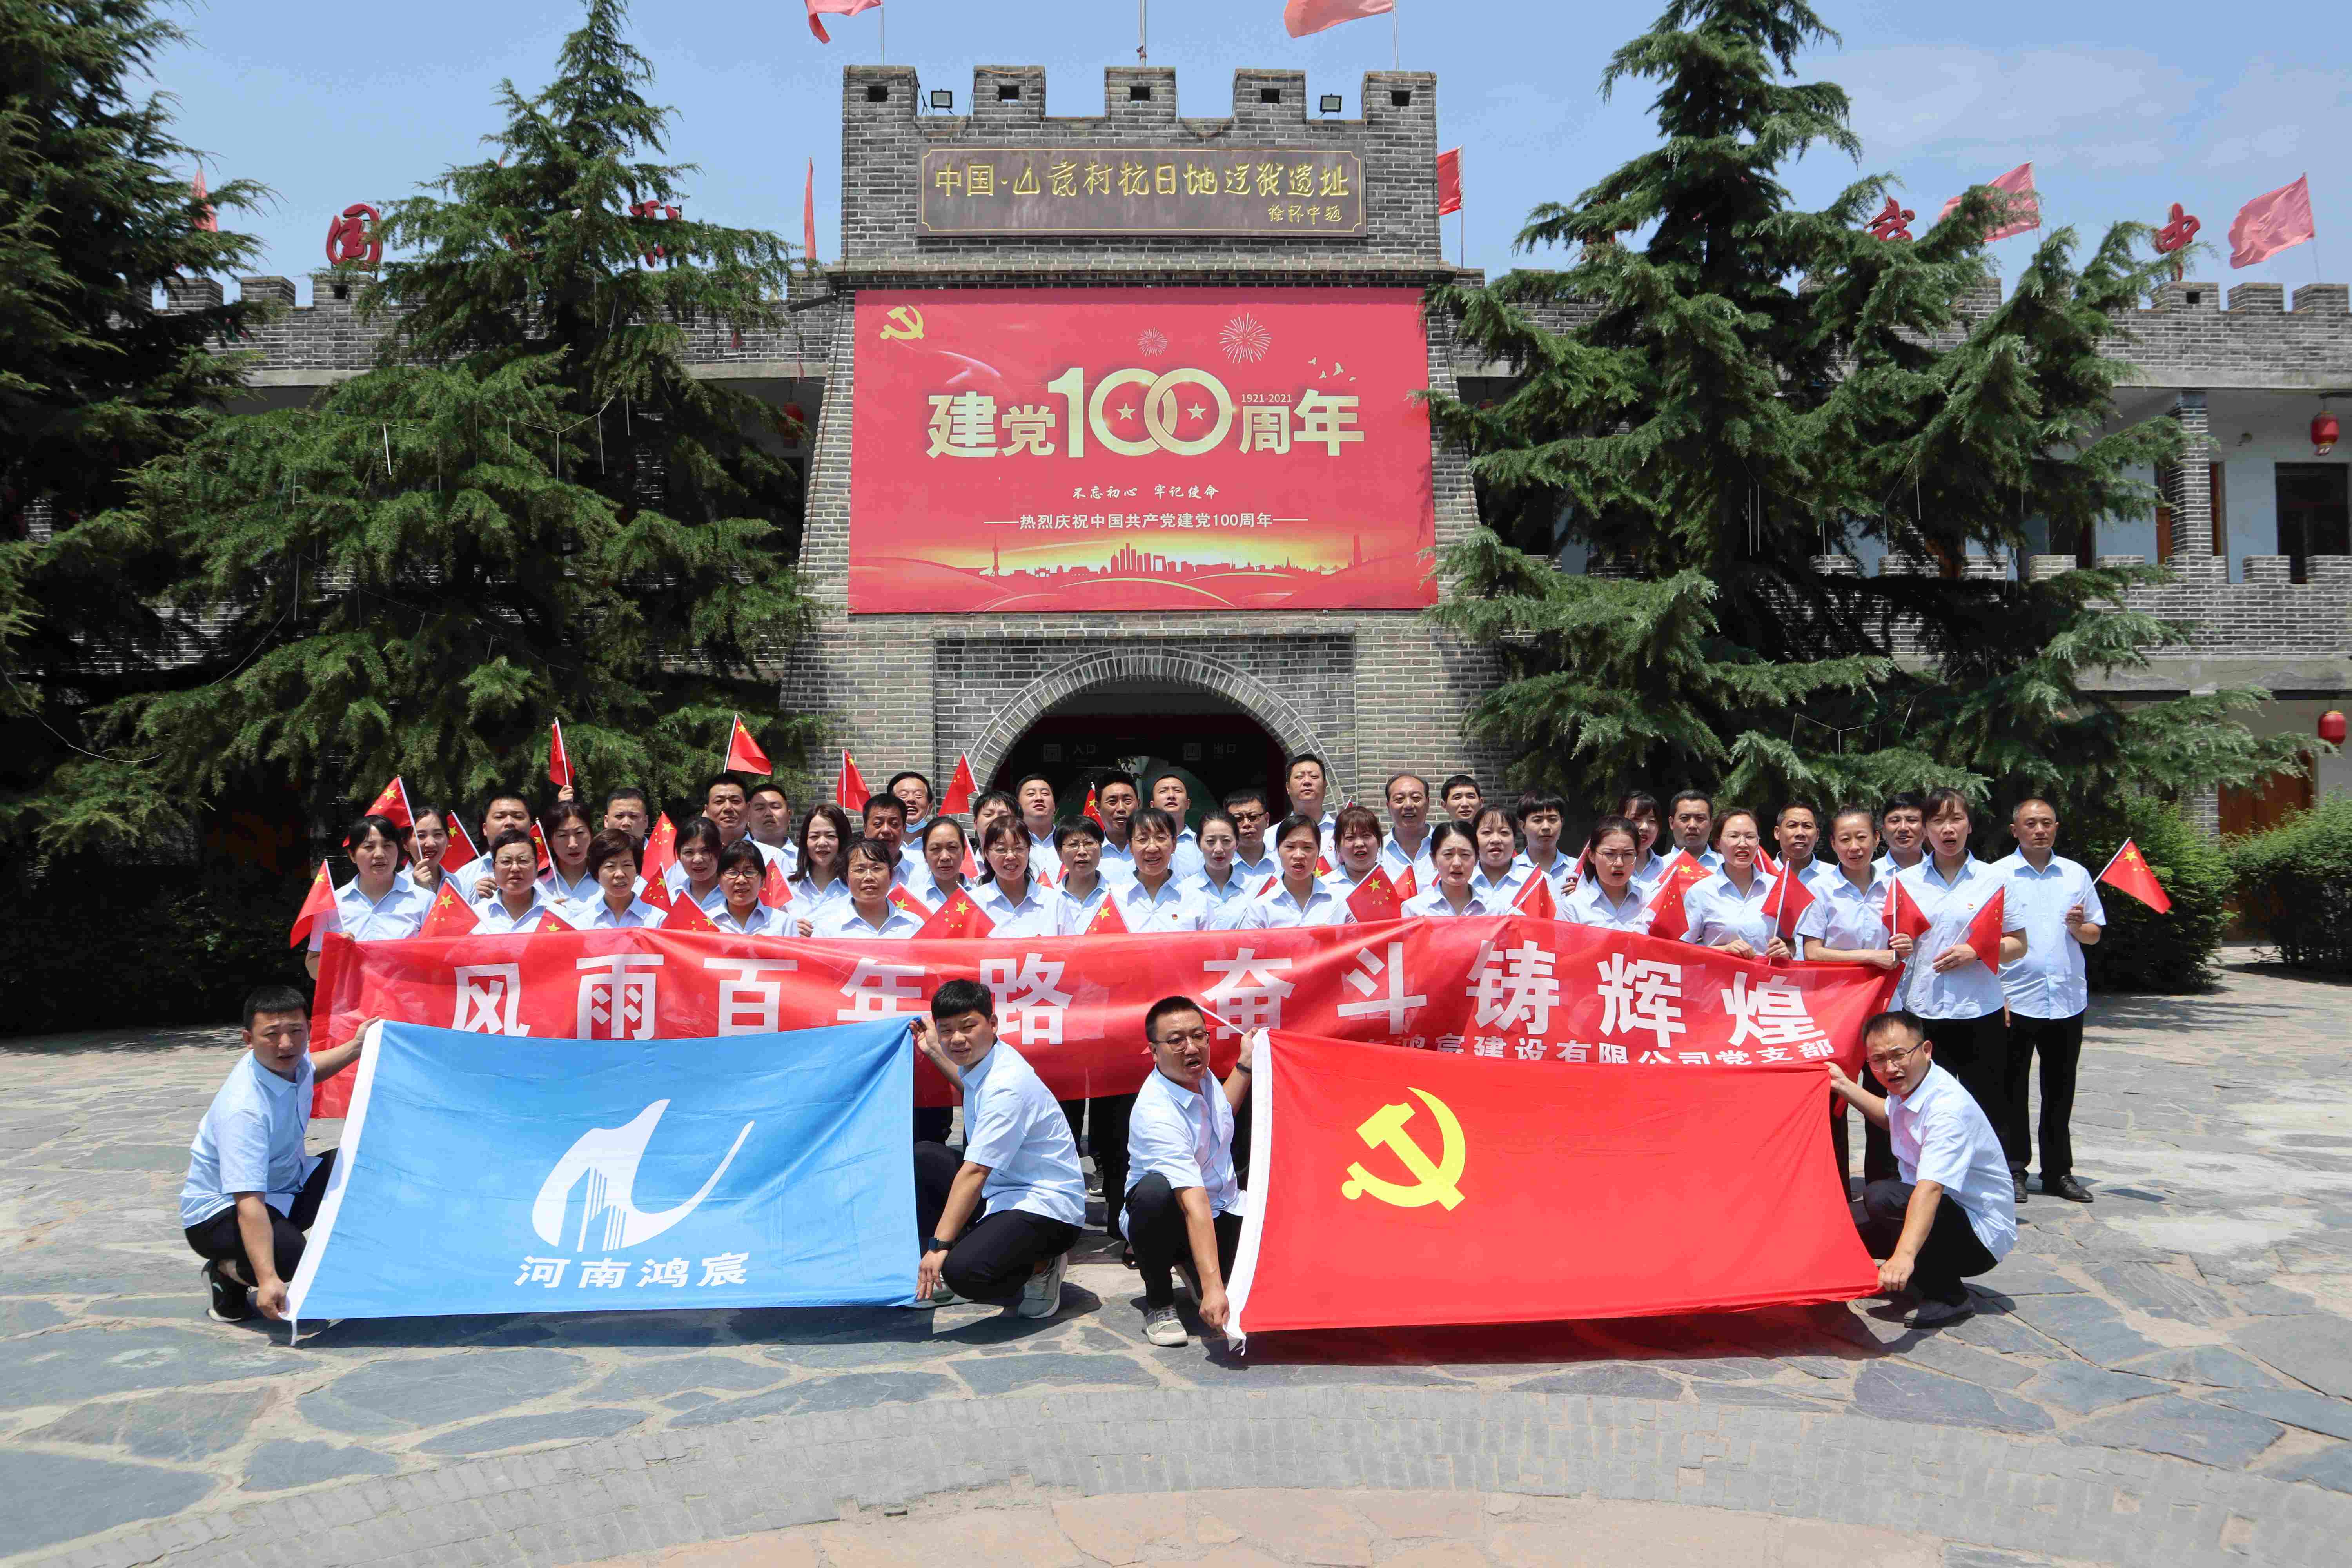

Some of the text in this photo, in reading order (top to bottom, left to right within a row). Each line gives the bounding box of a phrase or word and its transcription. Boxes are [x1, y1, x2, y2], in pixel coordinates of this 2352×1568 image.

[1241, 394, 1292, 403] 1921-2021
[926, 367, 1364, 459] 建党100周年
[1072, 484, 1220, 500] 不忘初心 牢记使命
[1020, 512, 1273, 530] 热烈庆祝中国共产党建党100周年
[514, 1252, 750, 1289] 河南鸿宸
